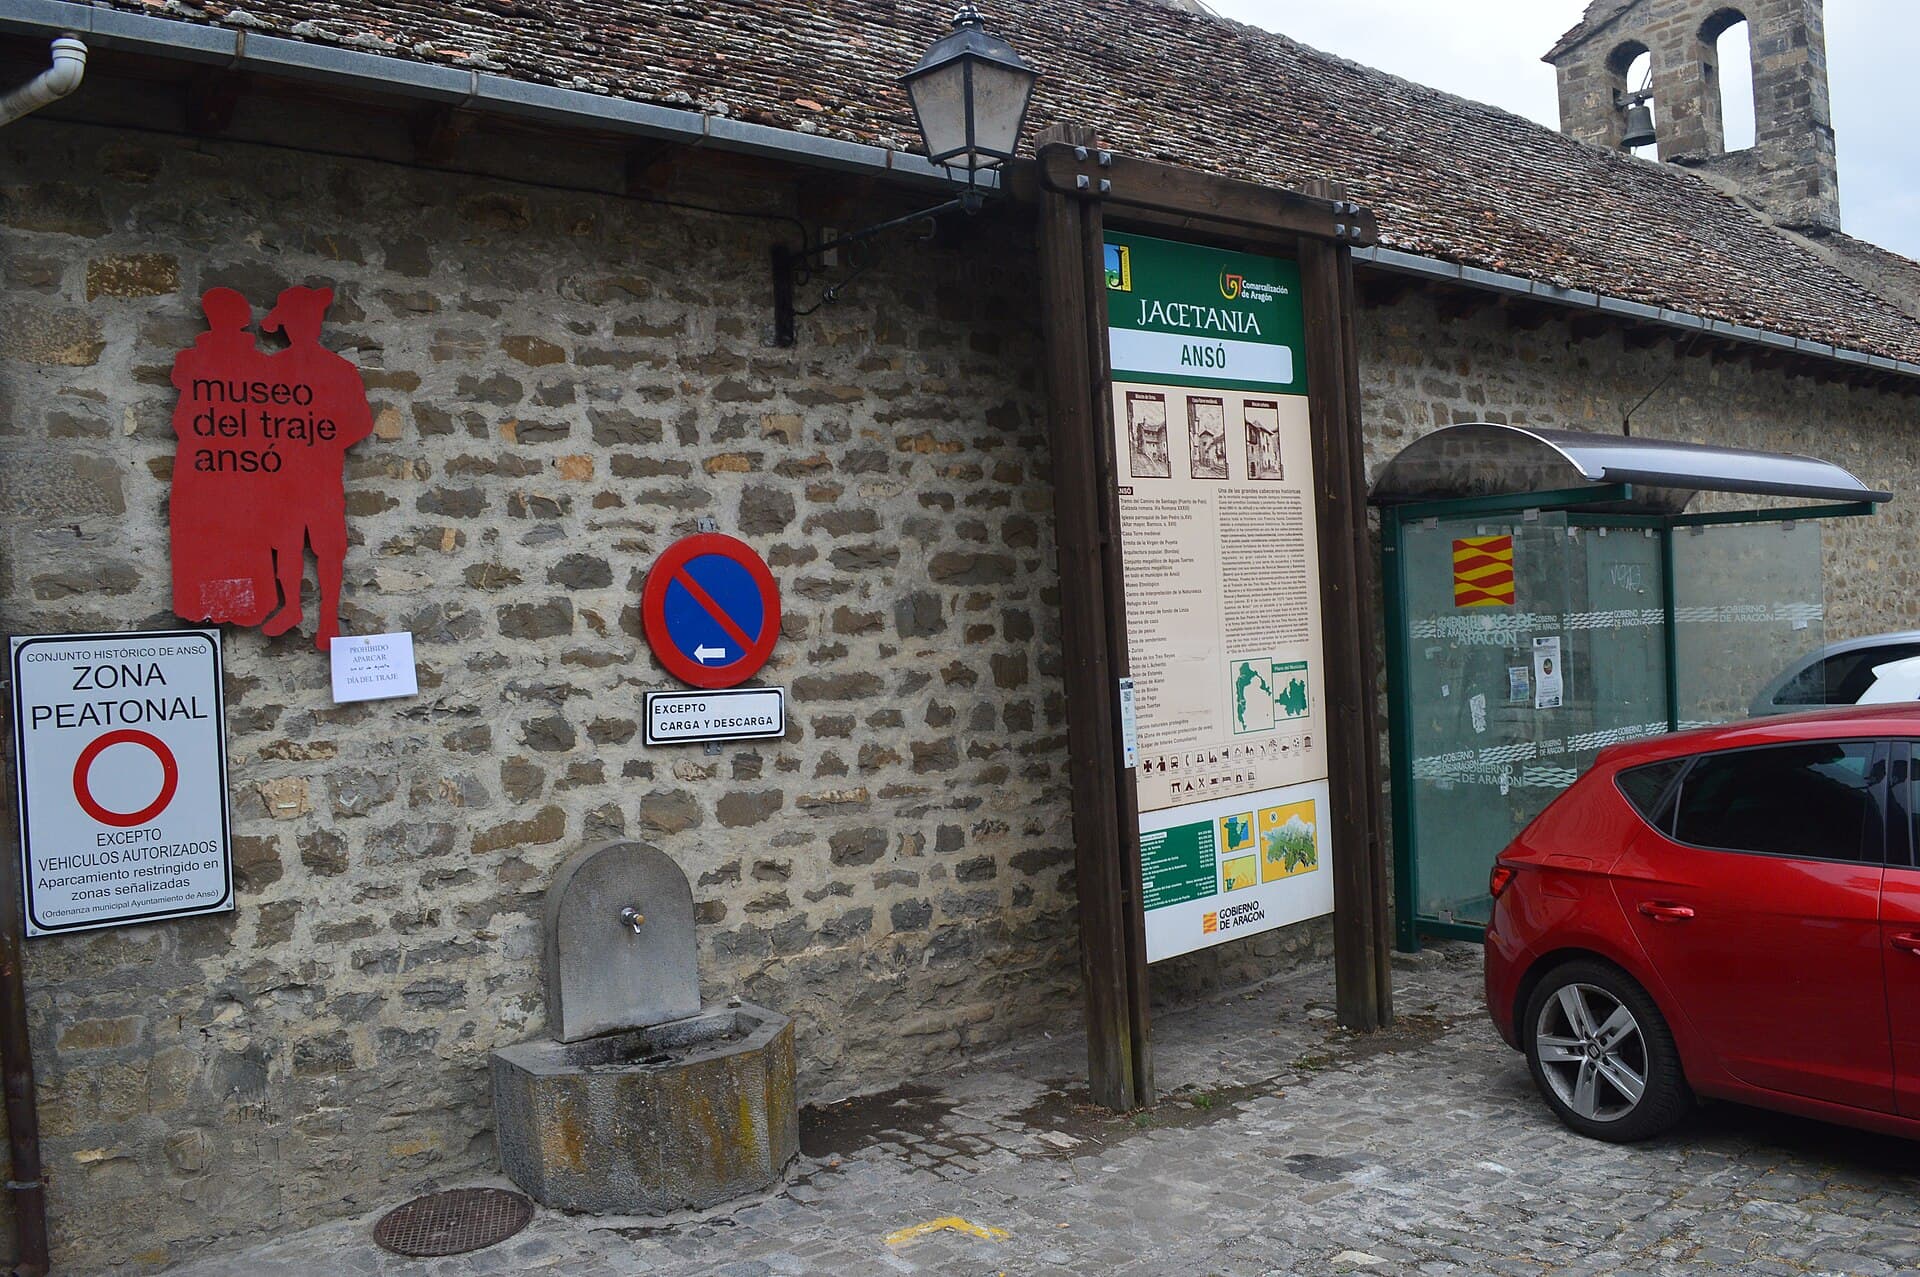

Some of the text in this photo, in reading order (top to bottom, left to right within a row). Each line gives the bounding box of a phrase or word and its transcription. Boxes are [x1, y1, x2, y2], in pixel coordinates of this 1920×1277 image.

[1241, 289, 1273, 303] de Aragón
[1136, 299, 1261, 335] JACETANIA
[1181, 342, 1226, 369] ANSÓ
[193, 379, 313, 406] museo
[193, 407, 337, 447] del traje
[194, 443, 282, 473] ansó
[27, 644, 207, 662] CONJUNTO HISTÓRICO DE ANSÓ
[349, 644, 389, 654] PROHIBIDO
[353, 654, 387, 663] APARCAR
[72, 663, 167, 691] ZONA
[375, 672, 399, 681] TRAJE
[31, 696, 208, 730] PEATONAL
[655, 703, 706, 715] EXCEPTO
[660, 716, 773, 731] CARGA Y DESCARGA
[1462, 773, 1476, 784] DE
[96, 828, 162, 847] EXCEPTO
[38, 840, 218, 872] VEHICULOS AUTORIZADOS
[38, 859, 219, 890] Aparcamiento restringido en
[71, 877, 191, 901] zonas señalizadas
[42, 889, 219, 920] (Ordenanza municipal Ayuntamiento de Ansó)
[1219, 900, 1260, 920] GOBIERNO
[1219, 910, 1265, 930] DE ARAGON
